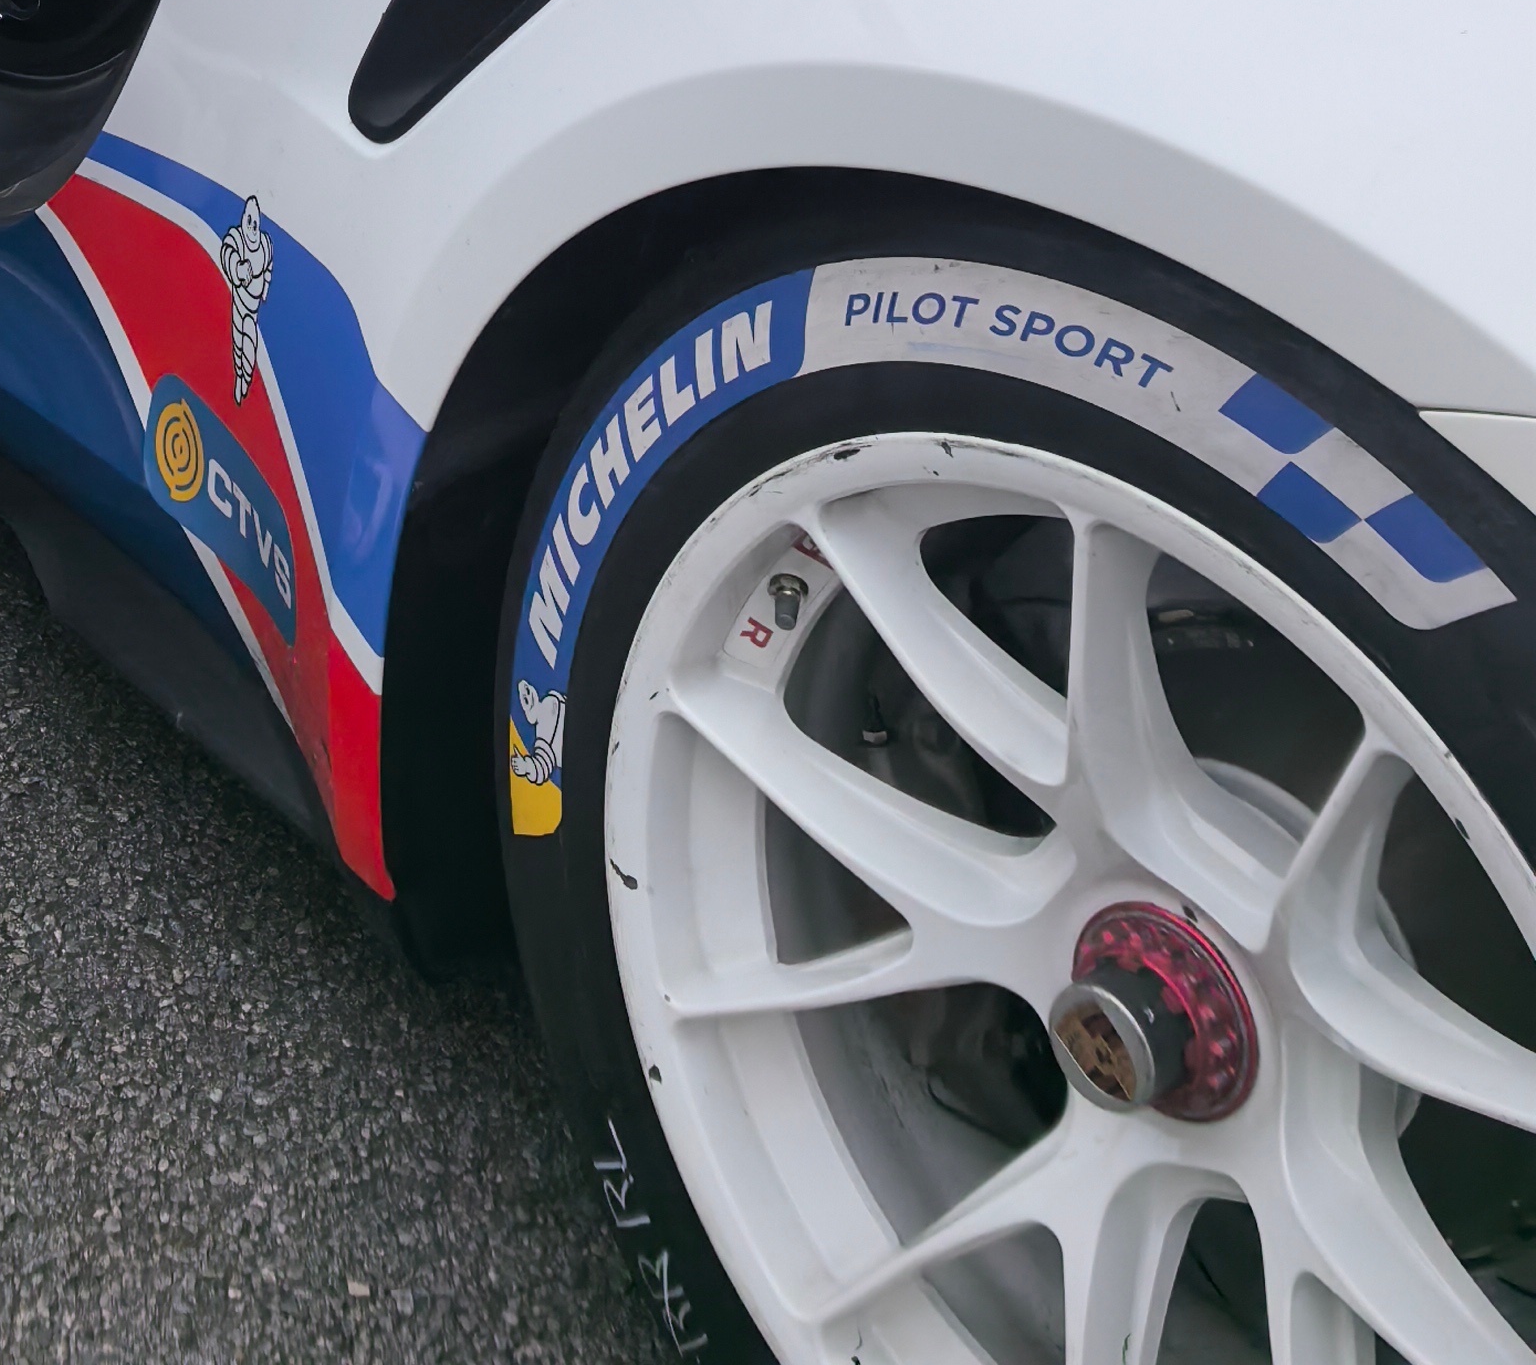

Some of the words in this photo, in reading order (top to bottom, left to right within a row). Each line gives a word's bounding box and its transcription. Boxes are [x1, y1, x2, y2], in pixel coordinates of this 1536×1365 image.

[844, 291, 980, 326] PILOT
[989, 304, 1174, 389] SPORT
[207, 458, 292, 610] CTVS
[528, 299, 774, 671] MICHELIN
